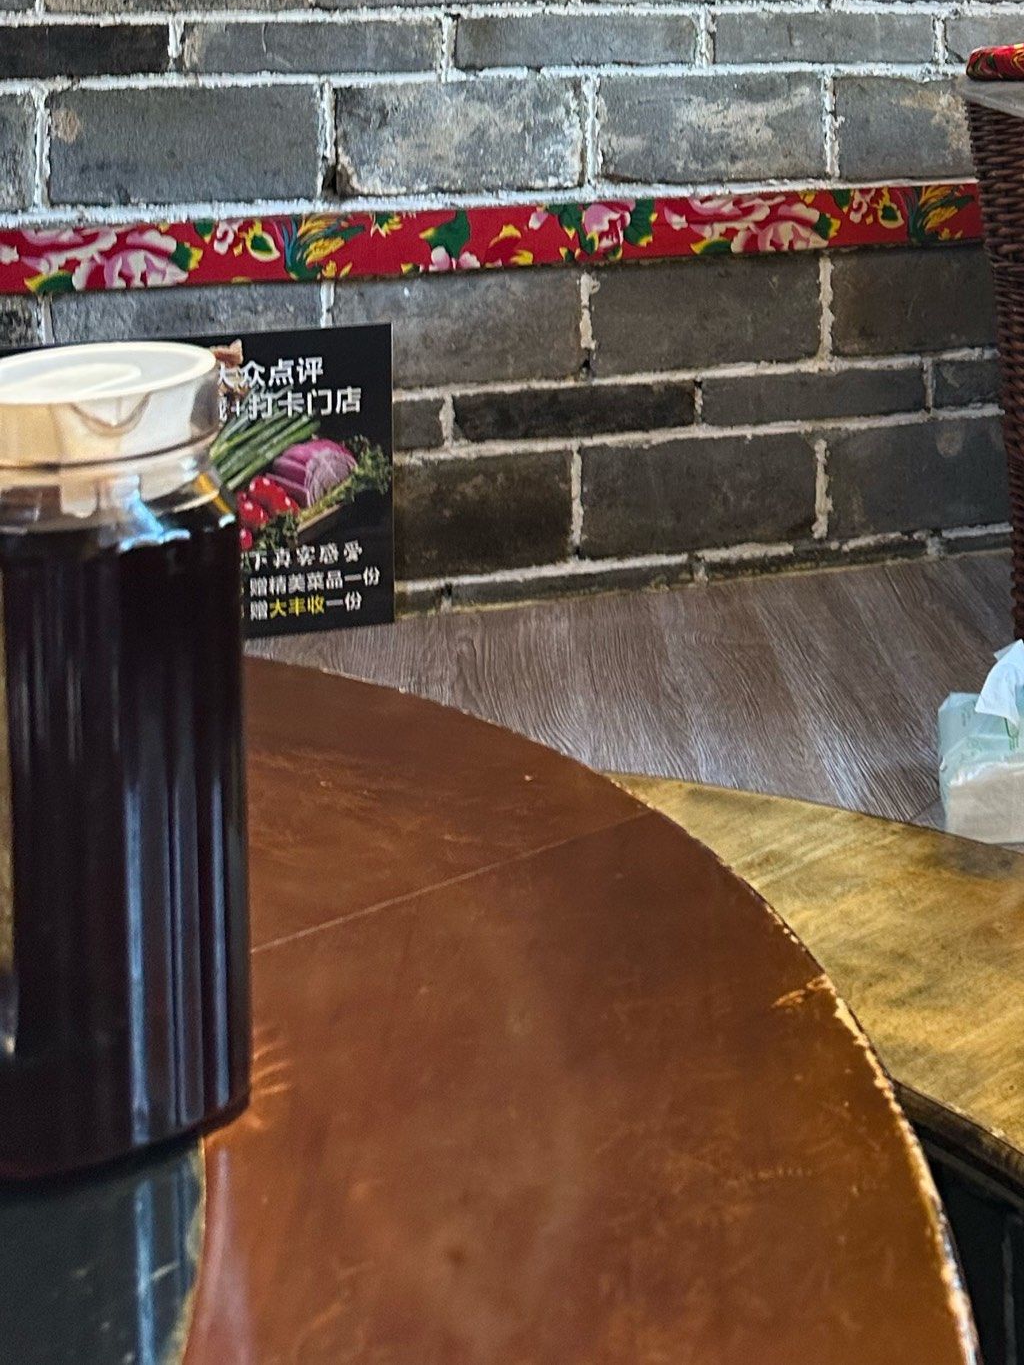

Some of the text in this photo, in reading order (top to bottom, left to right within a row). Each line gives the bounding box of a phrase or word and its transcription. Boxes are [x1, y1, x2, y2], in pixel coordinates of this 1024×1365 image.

[240, 540, 363, 572] 下真实感受
